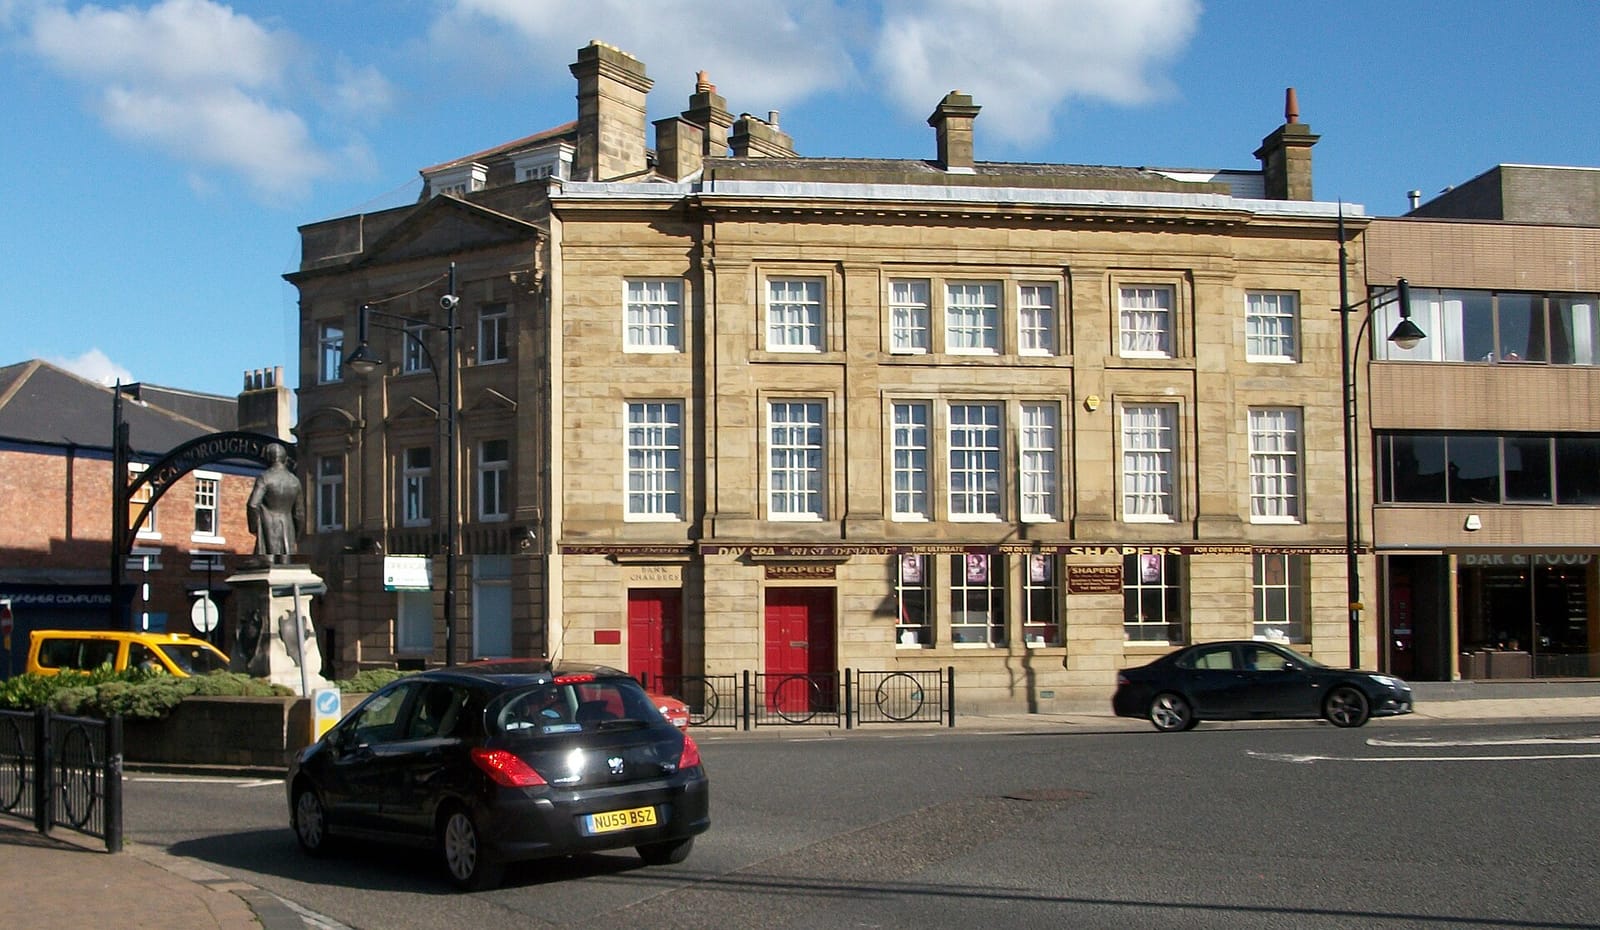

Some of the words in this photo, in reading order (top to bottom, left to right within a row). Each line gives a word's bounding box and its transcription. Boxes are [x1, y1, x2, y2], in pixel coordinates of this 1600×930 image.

[718, 547, 745, 556] DAY
[750, 547, 776, 556] SPA
[1070, 547, 1182, 555] SHAPERS
[767, 565, 834, 574] SHAPERS
[594, 812, 627, 828] NU59
[630, 810, 653, 824] BSZ
